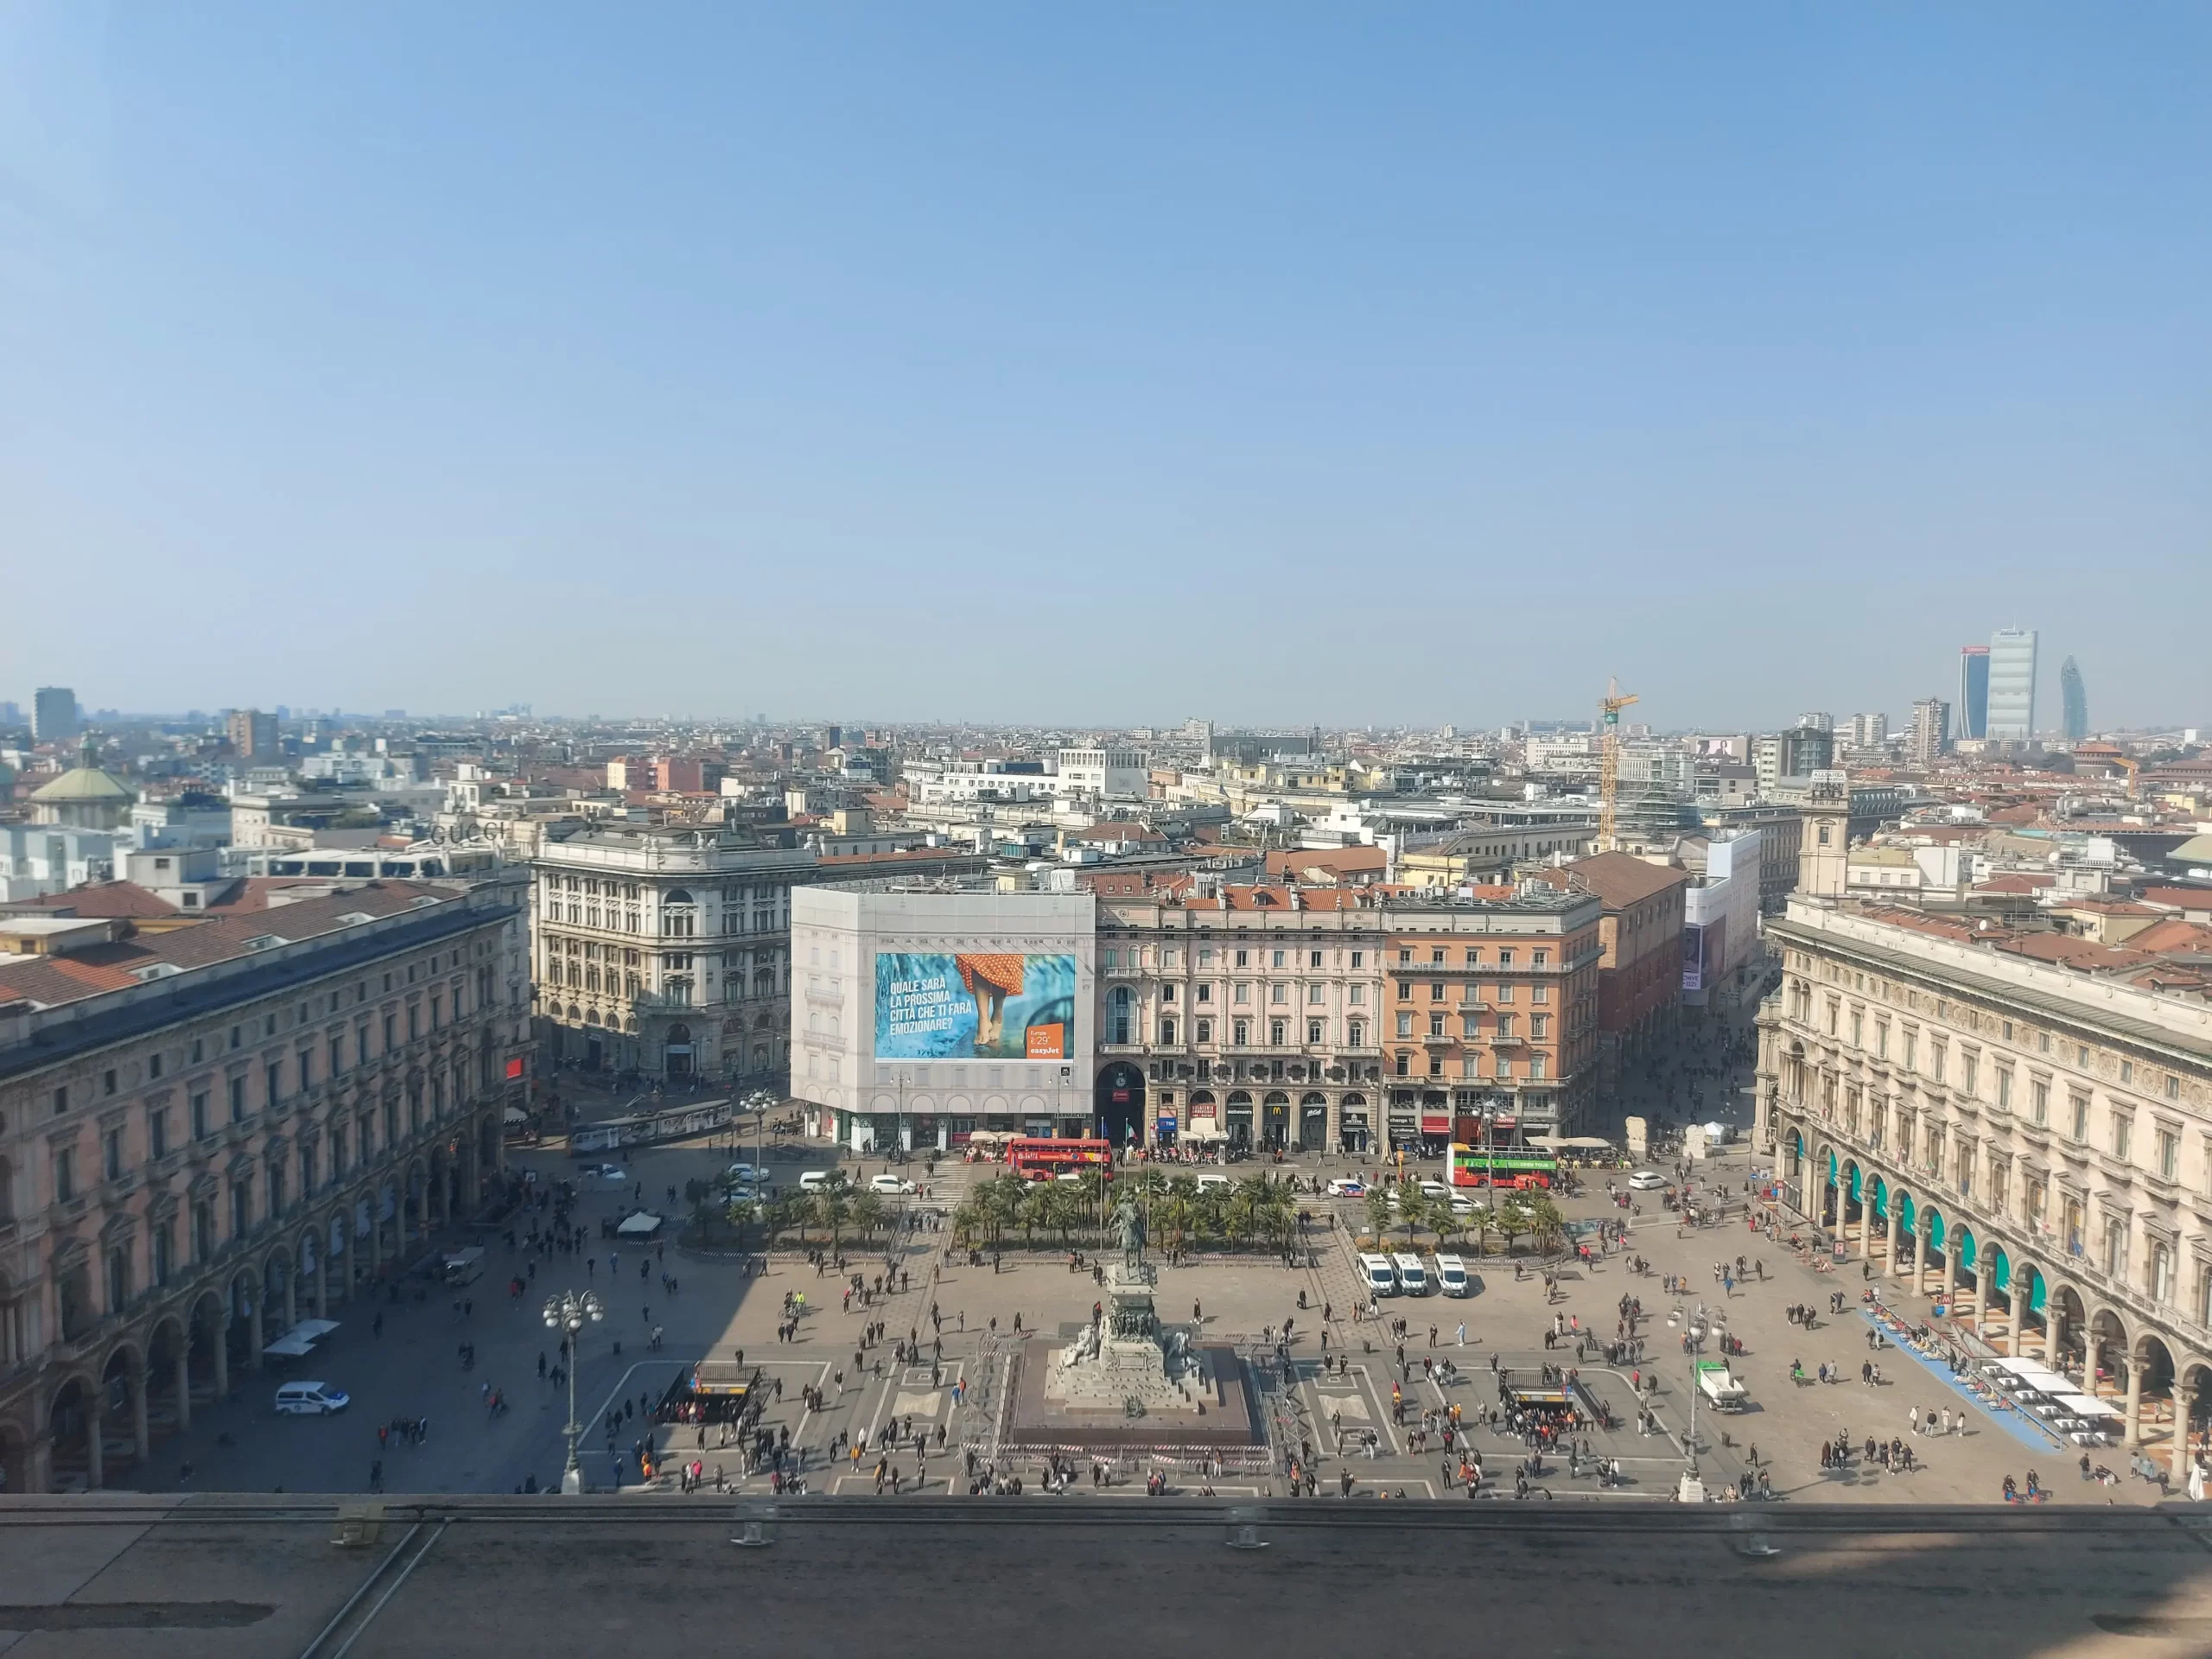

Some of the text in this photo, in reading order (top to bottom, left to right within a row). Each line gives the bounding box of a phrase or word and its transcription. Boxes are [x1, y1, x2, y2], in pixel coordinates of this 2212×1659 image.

[430, 821, 504, 845] GUCCI
[890, 975, 946, 995] QUALE SARÀ
[890, 990, 950, 1008] LA PROSSIMA
[890, 1000, 972, 1021] CITTÀ CHE TI FARÀ
[890, 1017, 953, 1036] EMOZIONARE?
